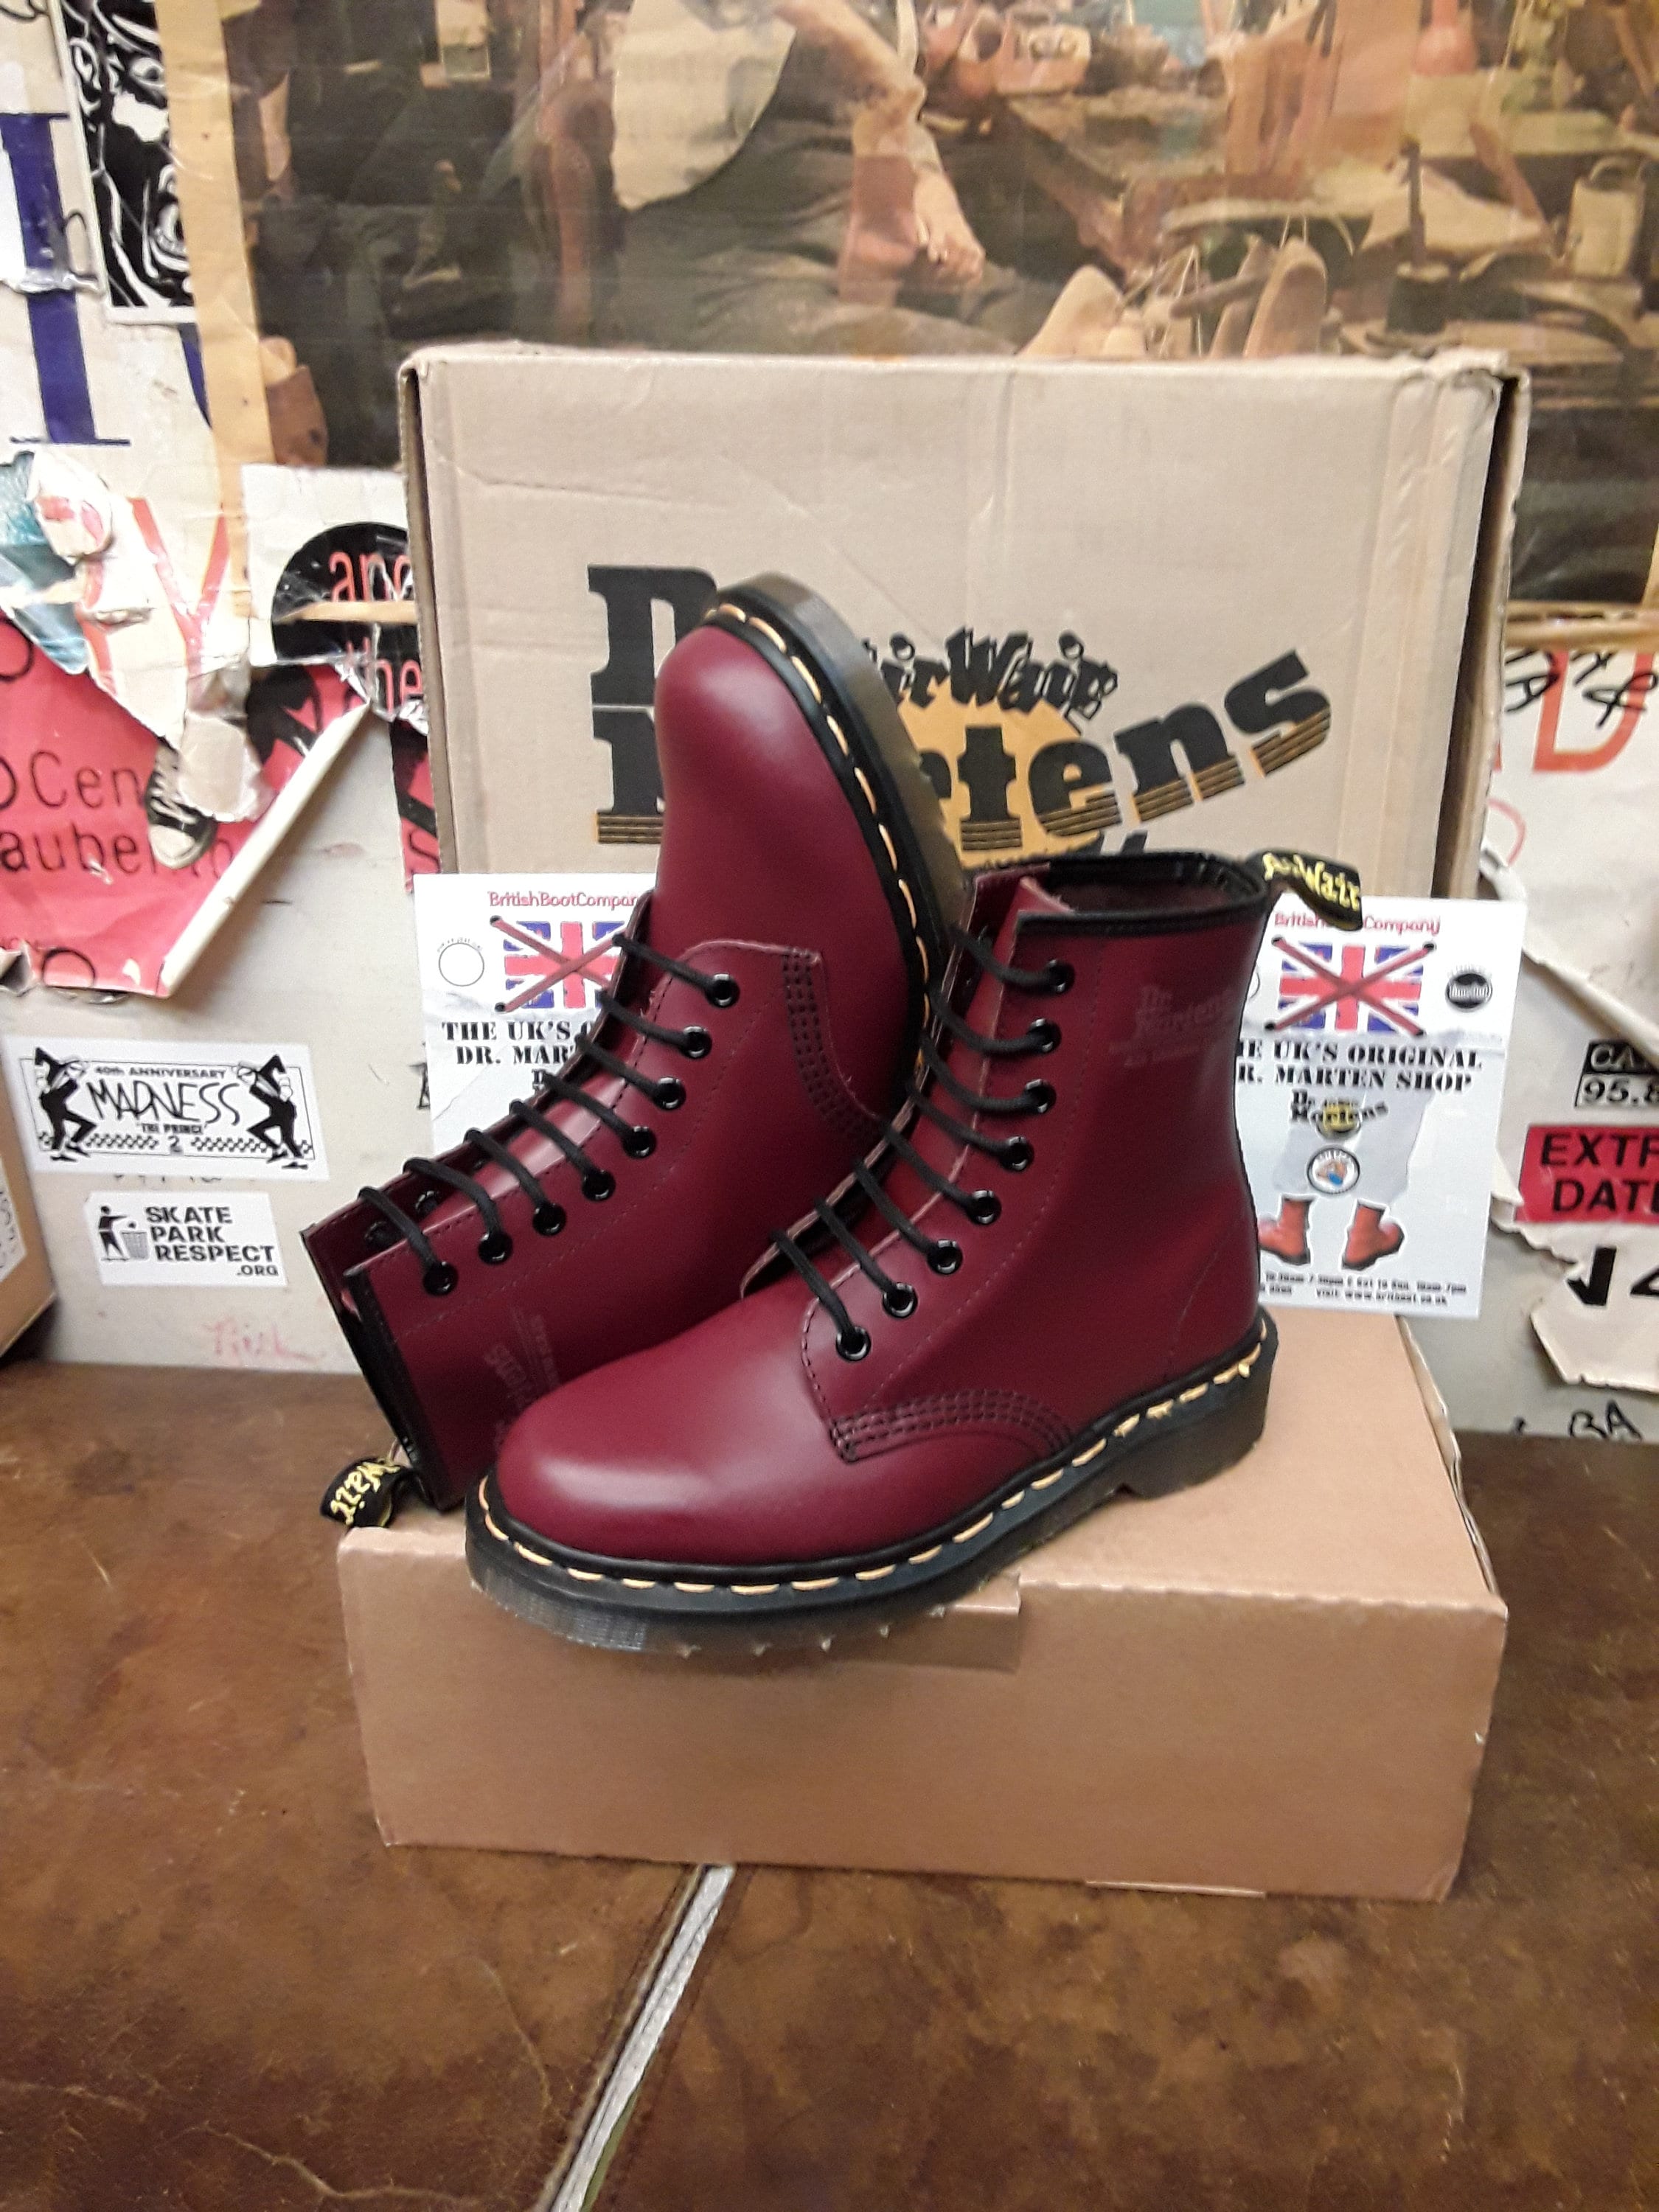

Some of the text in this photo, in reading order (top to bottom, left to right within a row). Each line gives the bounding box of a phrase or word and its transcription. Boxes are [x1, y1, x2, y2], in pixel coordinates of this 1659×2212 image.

[442, 1021, 497, 1040] THE
[508, 1021, 571, 1042] UK'S
[456, 1046, 501, 1065] DR.
[1274, 1040, 1338, 1061] UK'S
[1346, 1044, 1483, 1069] ORIGINAL
[128, 1067, 226, 1079] ANNIVERSARY
[1275, 1064, 1386, 1089] MARTEN
[1396, 1071, 1473, 1091] SHOP
[86, 1078, 241, 1126] MADNESS
[1554, 1180, 1659, 1213] DAT
[146, 1206, 232, 1225] SKATE
[150, 1226, 224, 1244] PARK
[154, 1245, 274, 1263] RESPECT
[237, 1265, 279, 1277] .ORG
